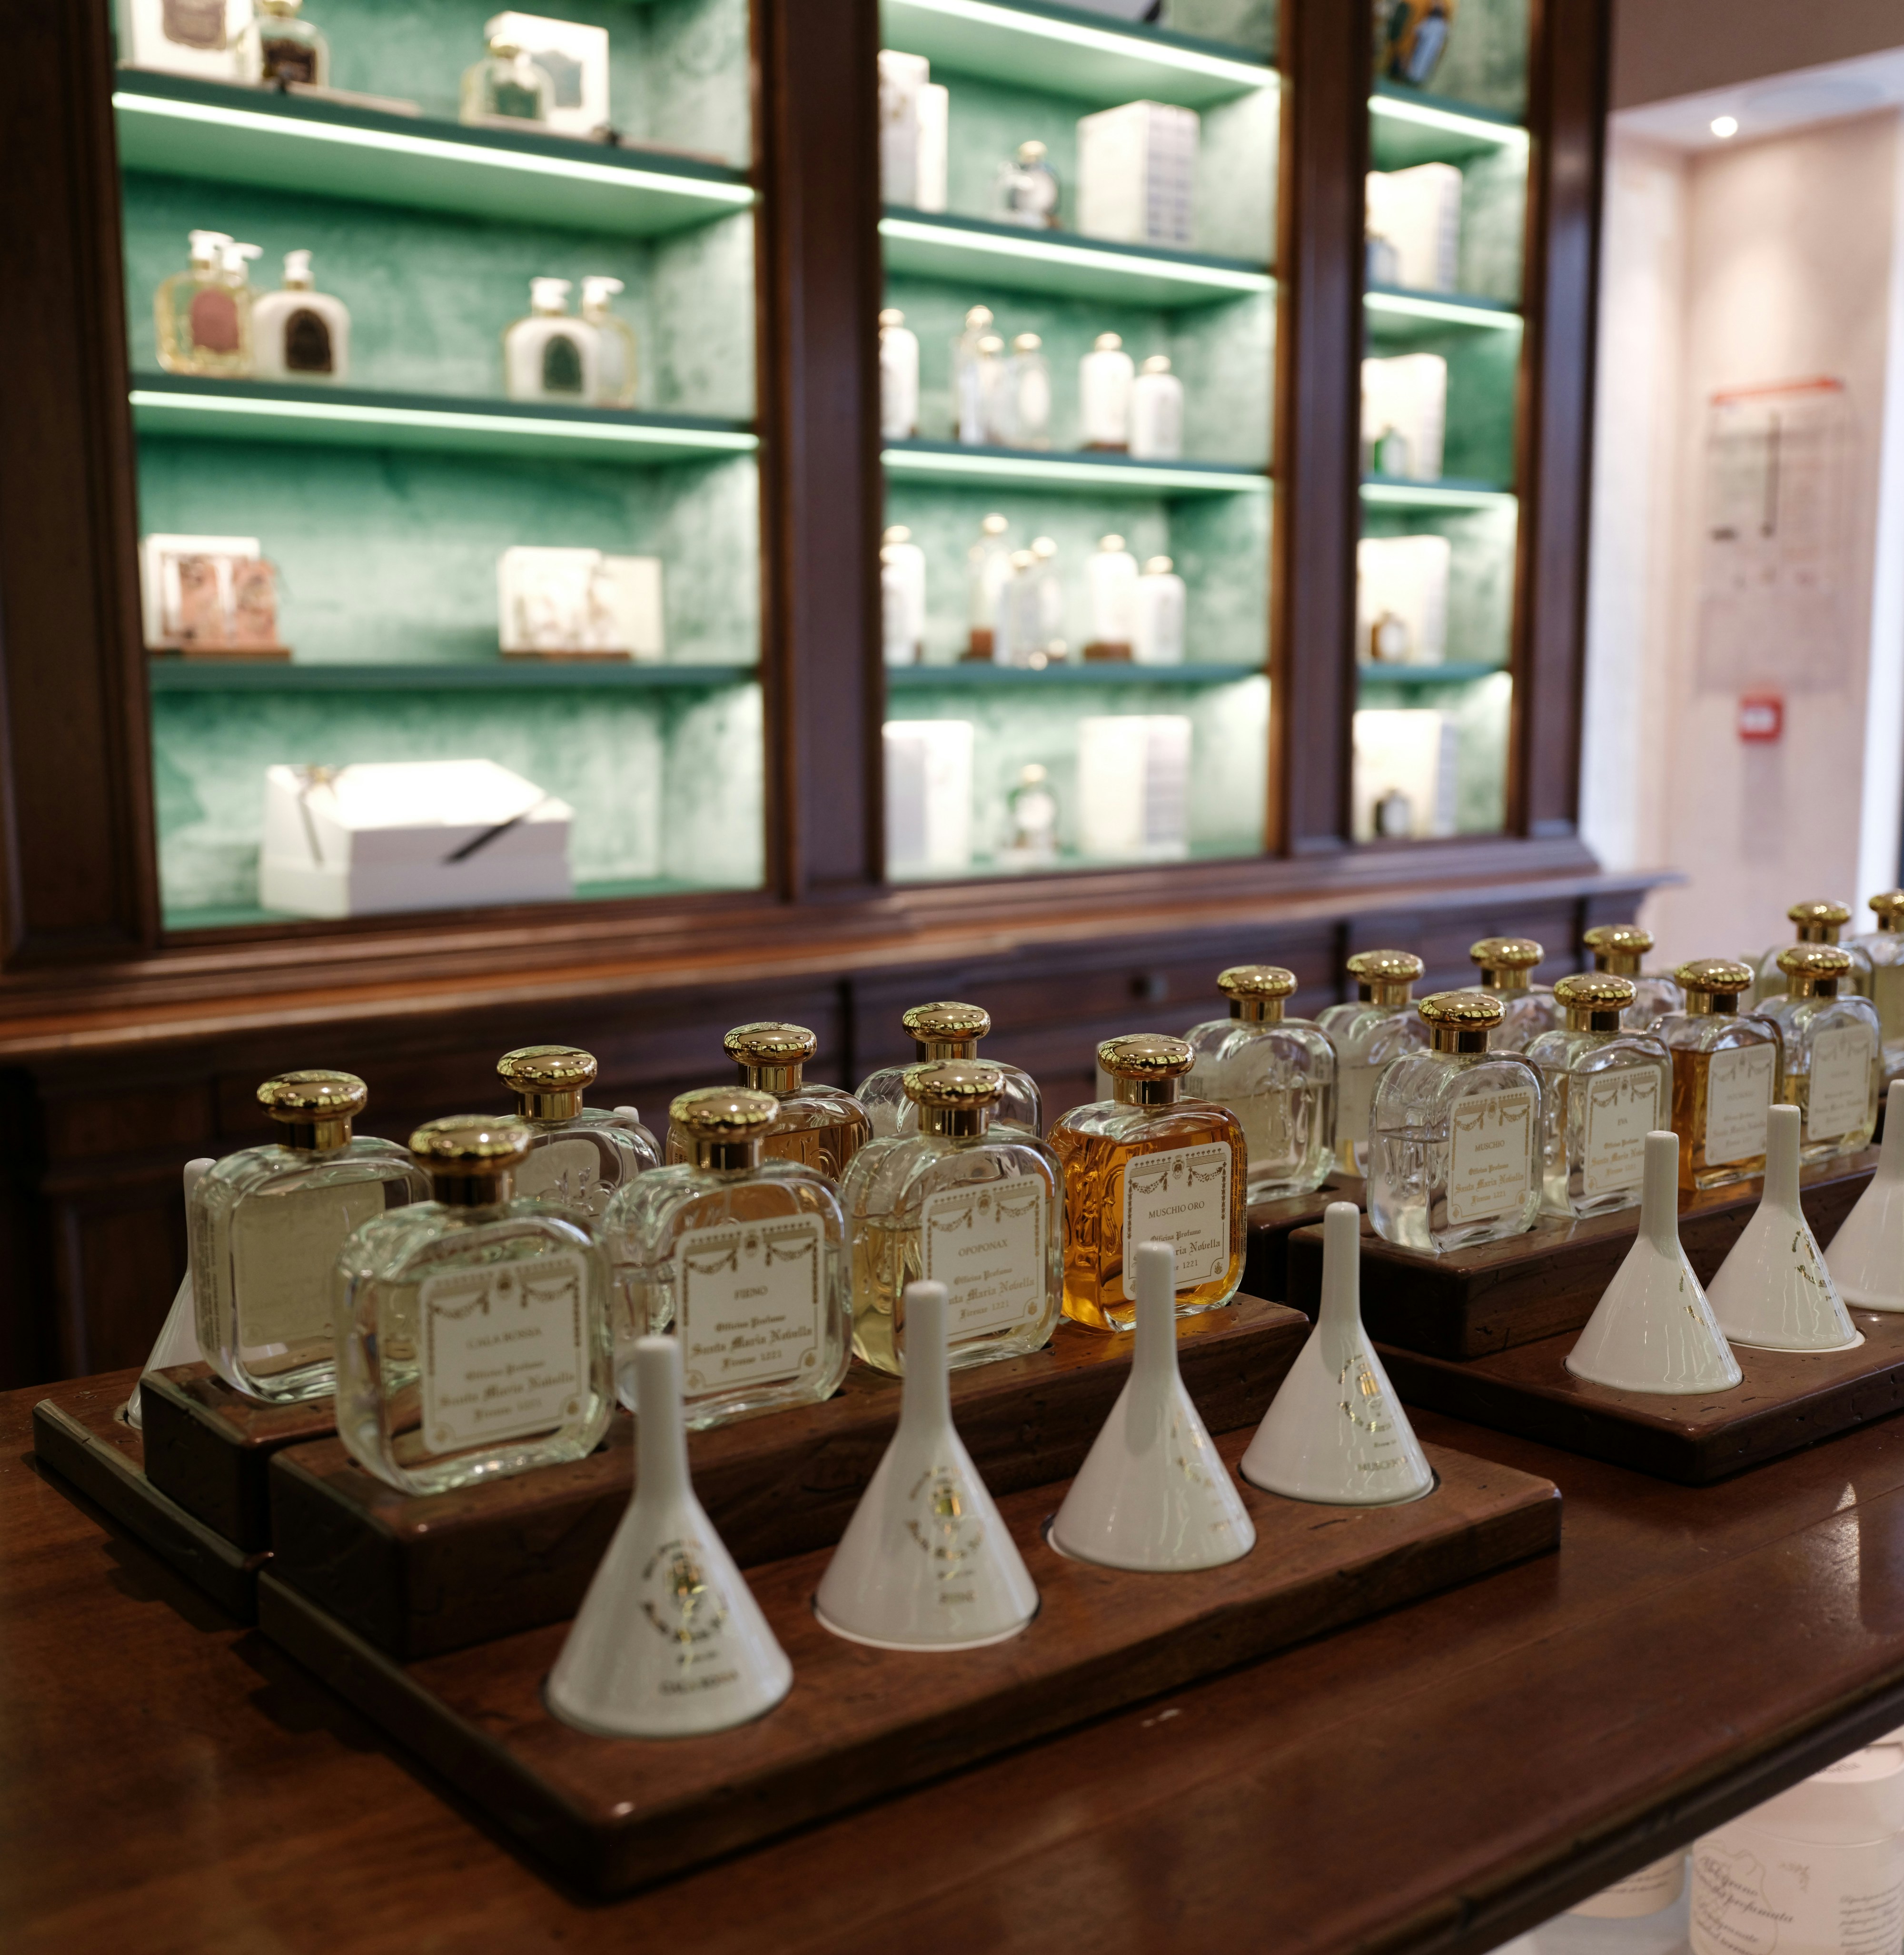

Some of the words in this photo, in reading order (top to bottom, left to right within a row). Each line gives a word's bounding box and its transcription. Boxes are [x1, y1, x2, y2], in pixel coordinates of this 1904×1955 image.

[1475, 1140, 1505, 1152] MUSCHIO
[1454, 1184, 1474, 1196] Santa
[1477, 1179, 1497, 1191] Maria
[1149, 1206, 1186, 1219] MUSCHIO
[1188, 1201, 1205, 1212] ORO
[1176, 1229, 1201, 1240] Profumo
[958, 1240, 1008, 1257] OPOPONAX
[1174, 1247, 1187, 1255] ria
[1189, 1239, 1220, 1254] Novella
[1183, 1260, 1198, 1269] 1221
[734, 1286, 768, 1300] FIENO
[949, 1294, 963, 1305] nta
[967, 1286, 996, 1303] Maria
[999, 1278, 1035, 1293] Novella
[992, 1300, 1009, 1311] 1221
